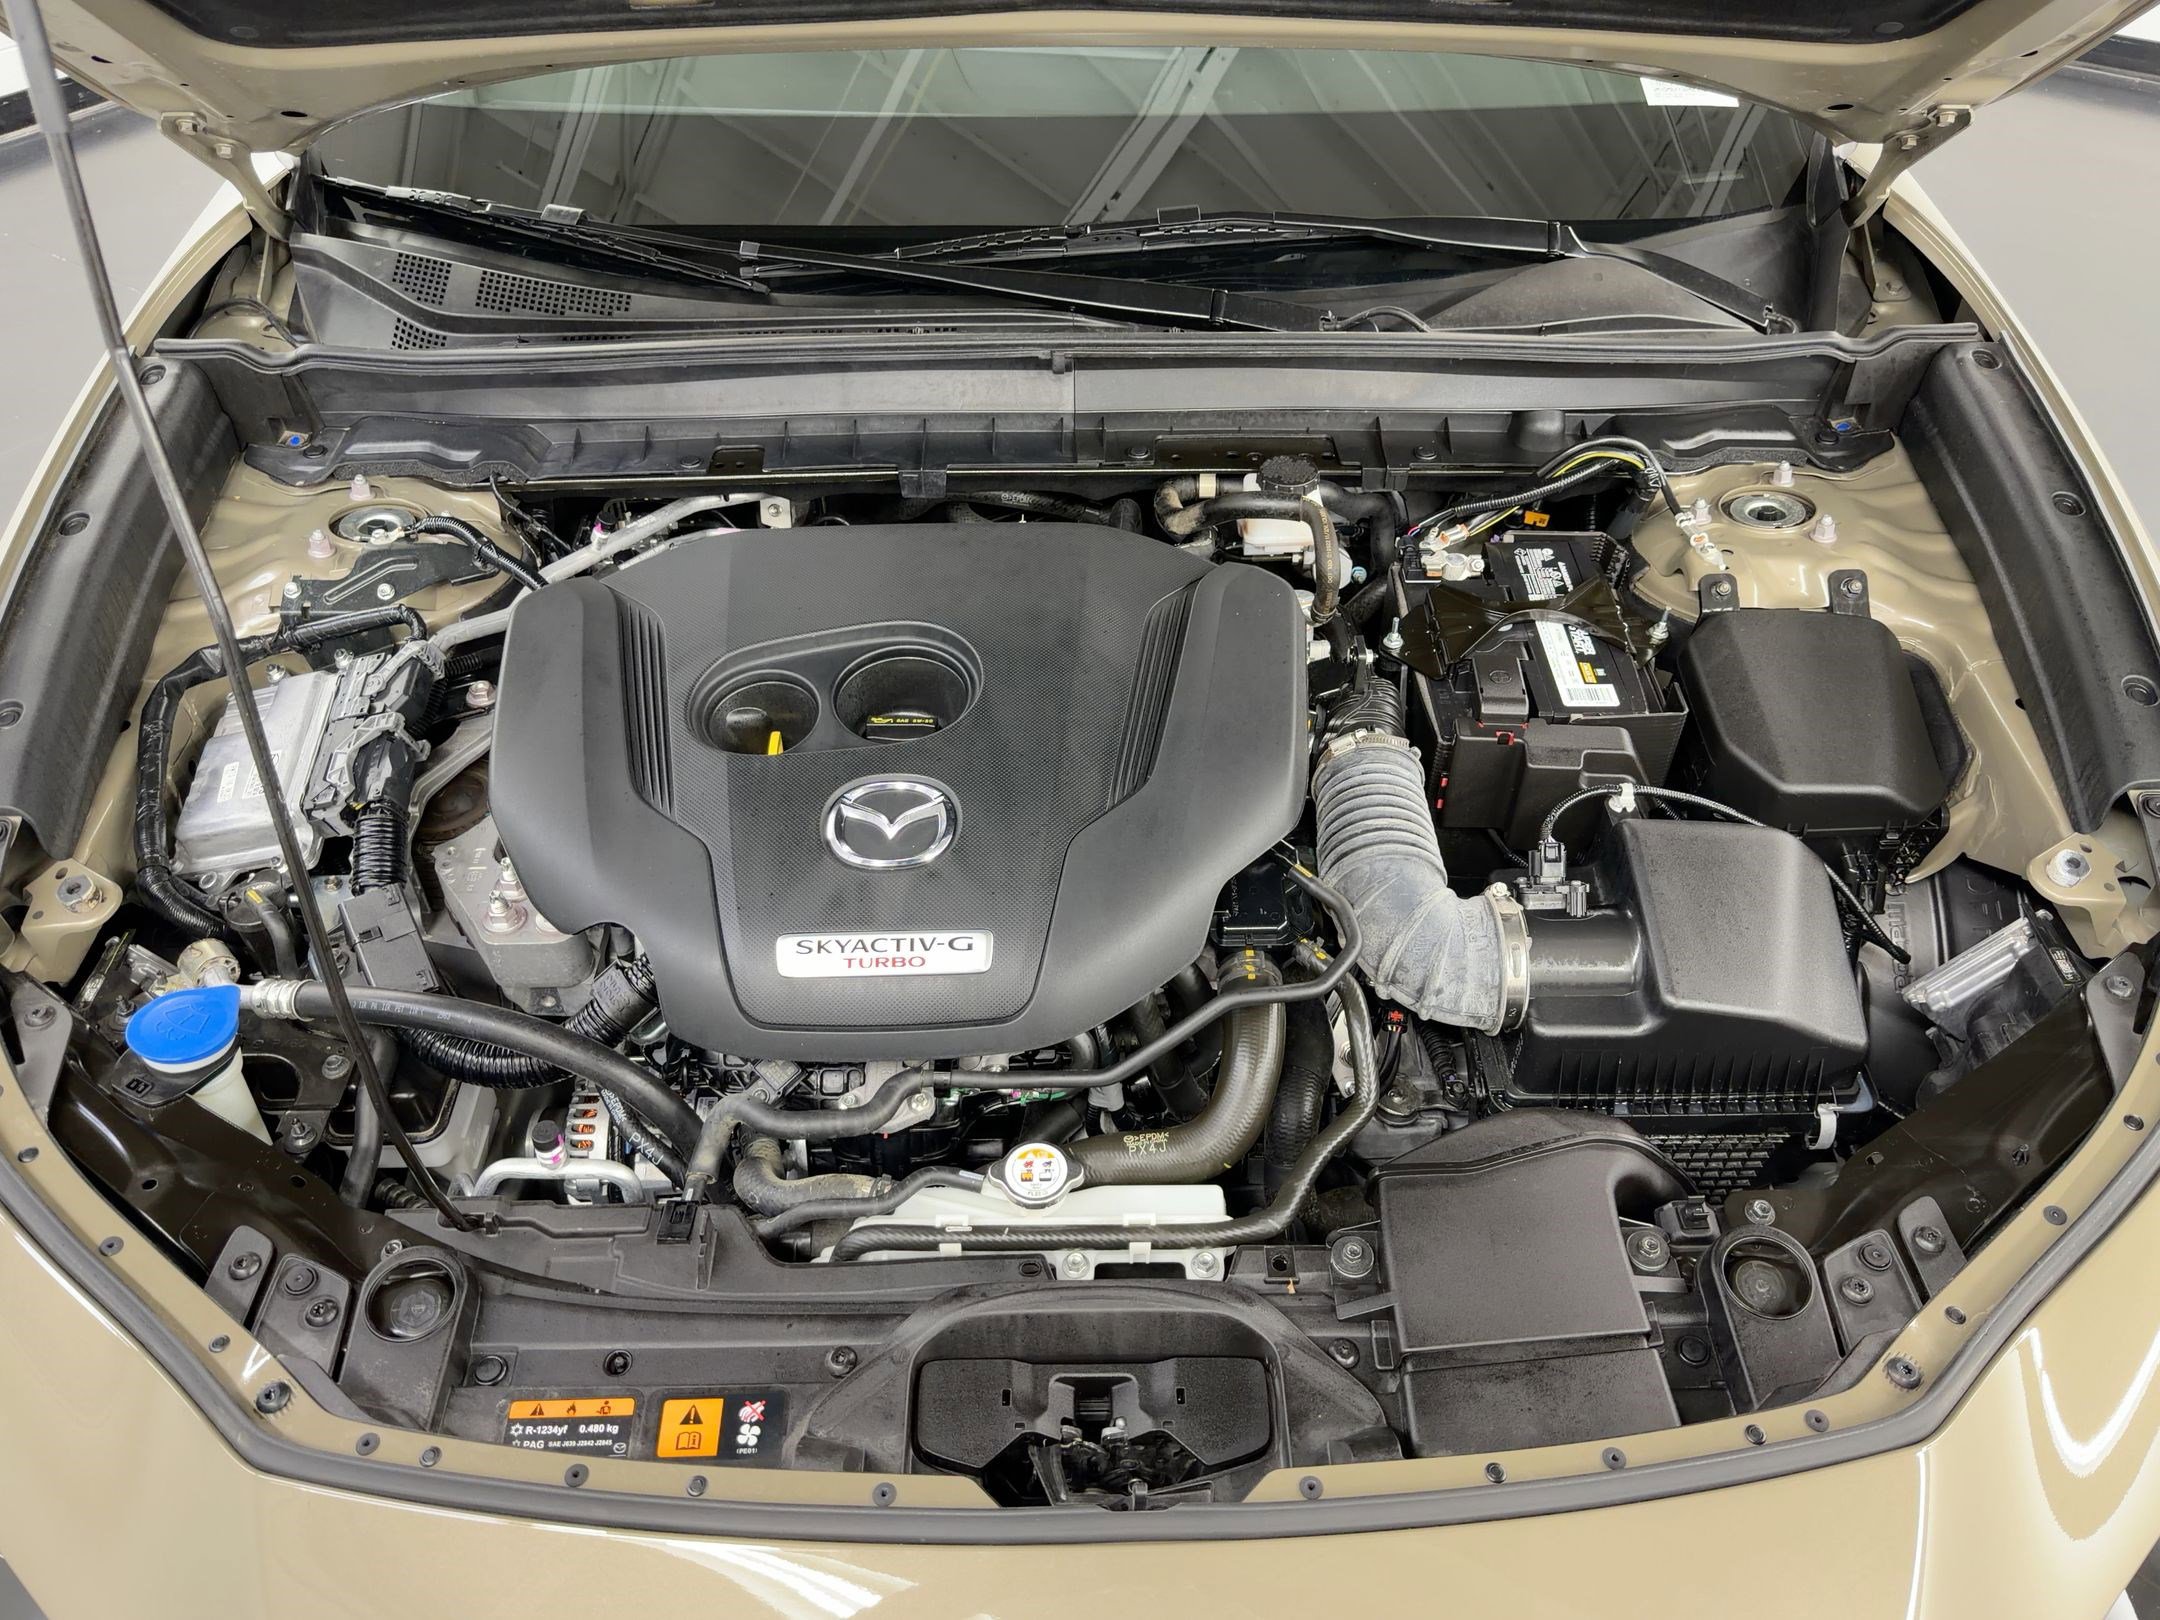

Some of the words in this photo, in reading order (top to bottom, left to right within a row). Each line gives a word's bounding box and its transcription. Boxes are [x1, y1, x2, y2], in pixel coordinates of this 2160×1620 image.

[795, 936, 974, 955] SKYACTIV-G
[843, 956, 926, 969] TURBO
[629, 1132, 664, 1166] PX4J
[525, 1424, 568, 1436] R-1234yf
[579, 1424, 605, 1434] 0.480
[606, 1423, 619, 1435] kg
[523, 1440, 545, 1450] PAG
